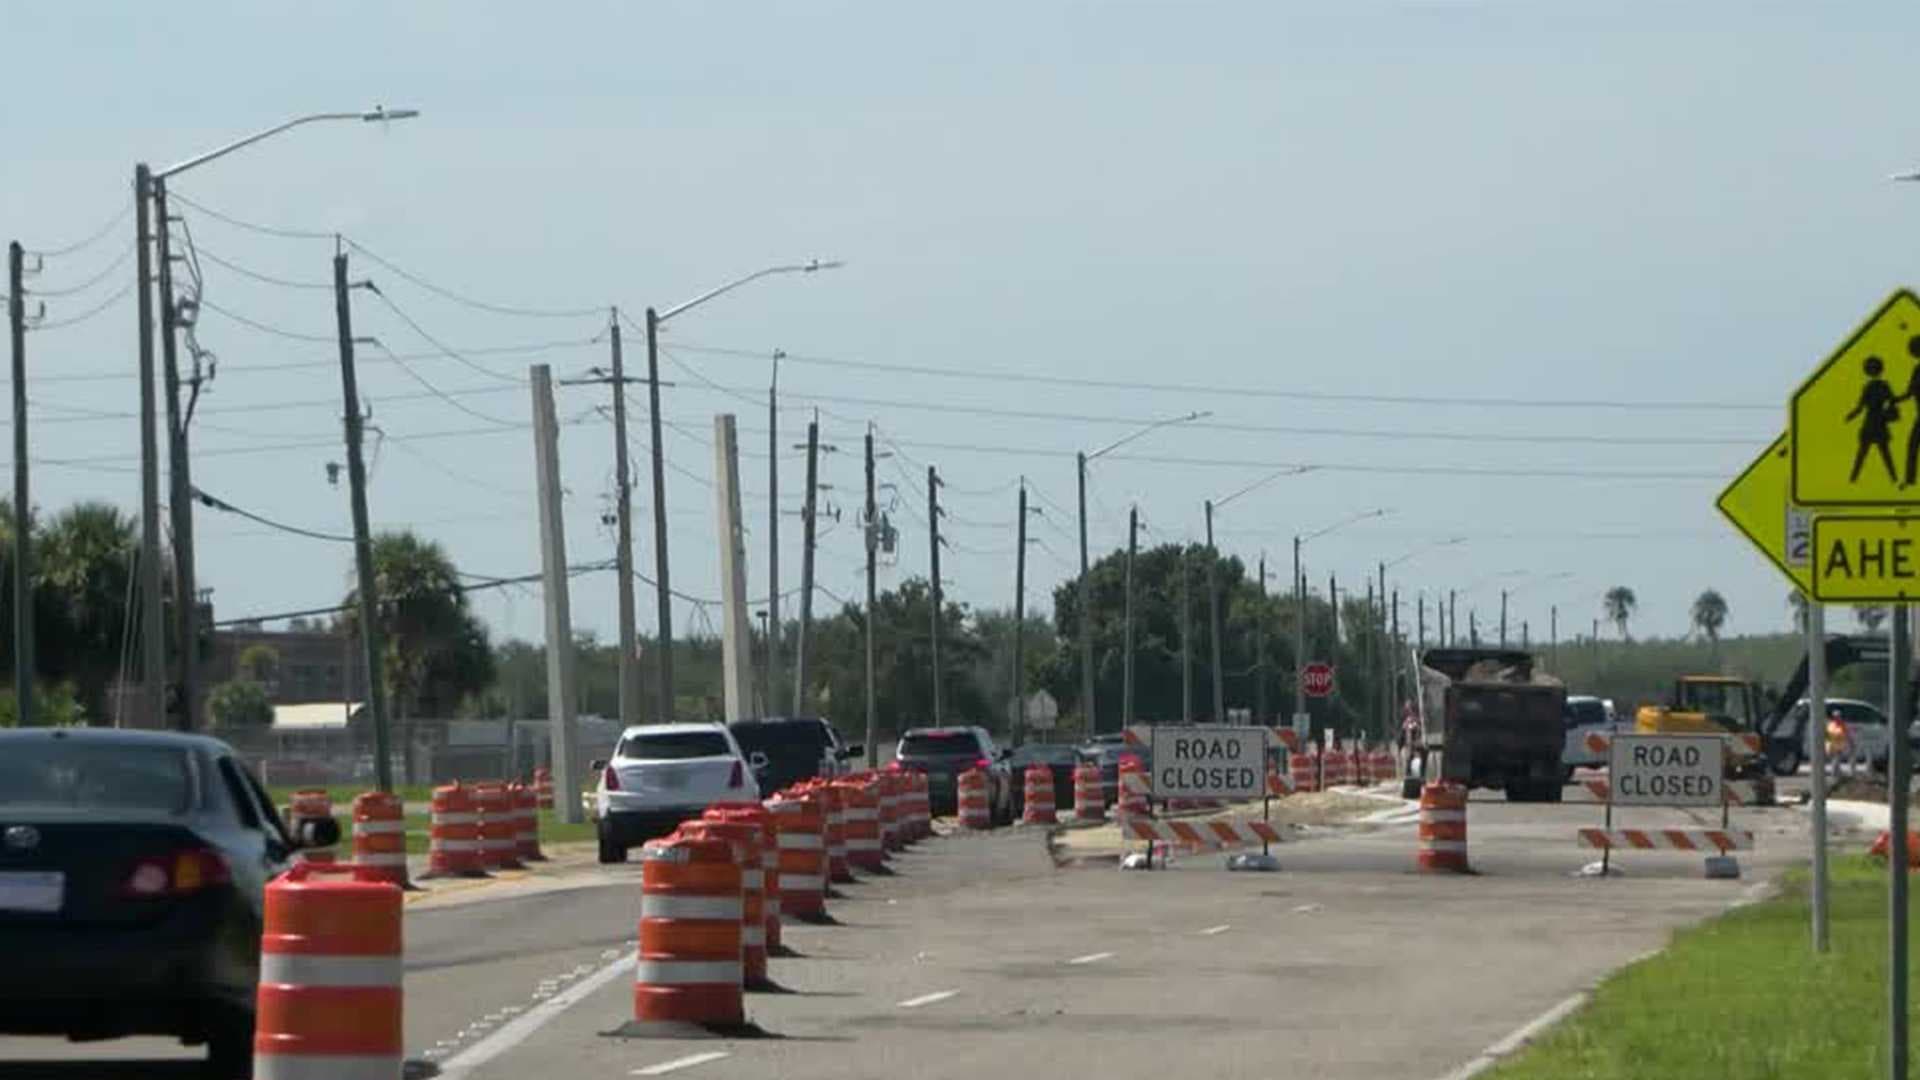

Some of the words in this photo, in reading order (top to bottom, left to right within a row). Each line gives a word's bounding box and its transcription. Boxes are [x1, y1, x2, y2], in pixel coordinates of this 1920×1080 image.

[1303, 672, 1332, 686] STOP
[1175, 738, 1241, 760] ROAD
[1634, 745, 1700, 767] ROAD
[1162, 767, 1255, 789] CLOSED
[1620, 775, 1713, 796] CLOSED
